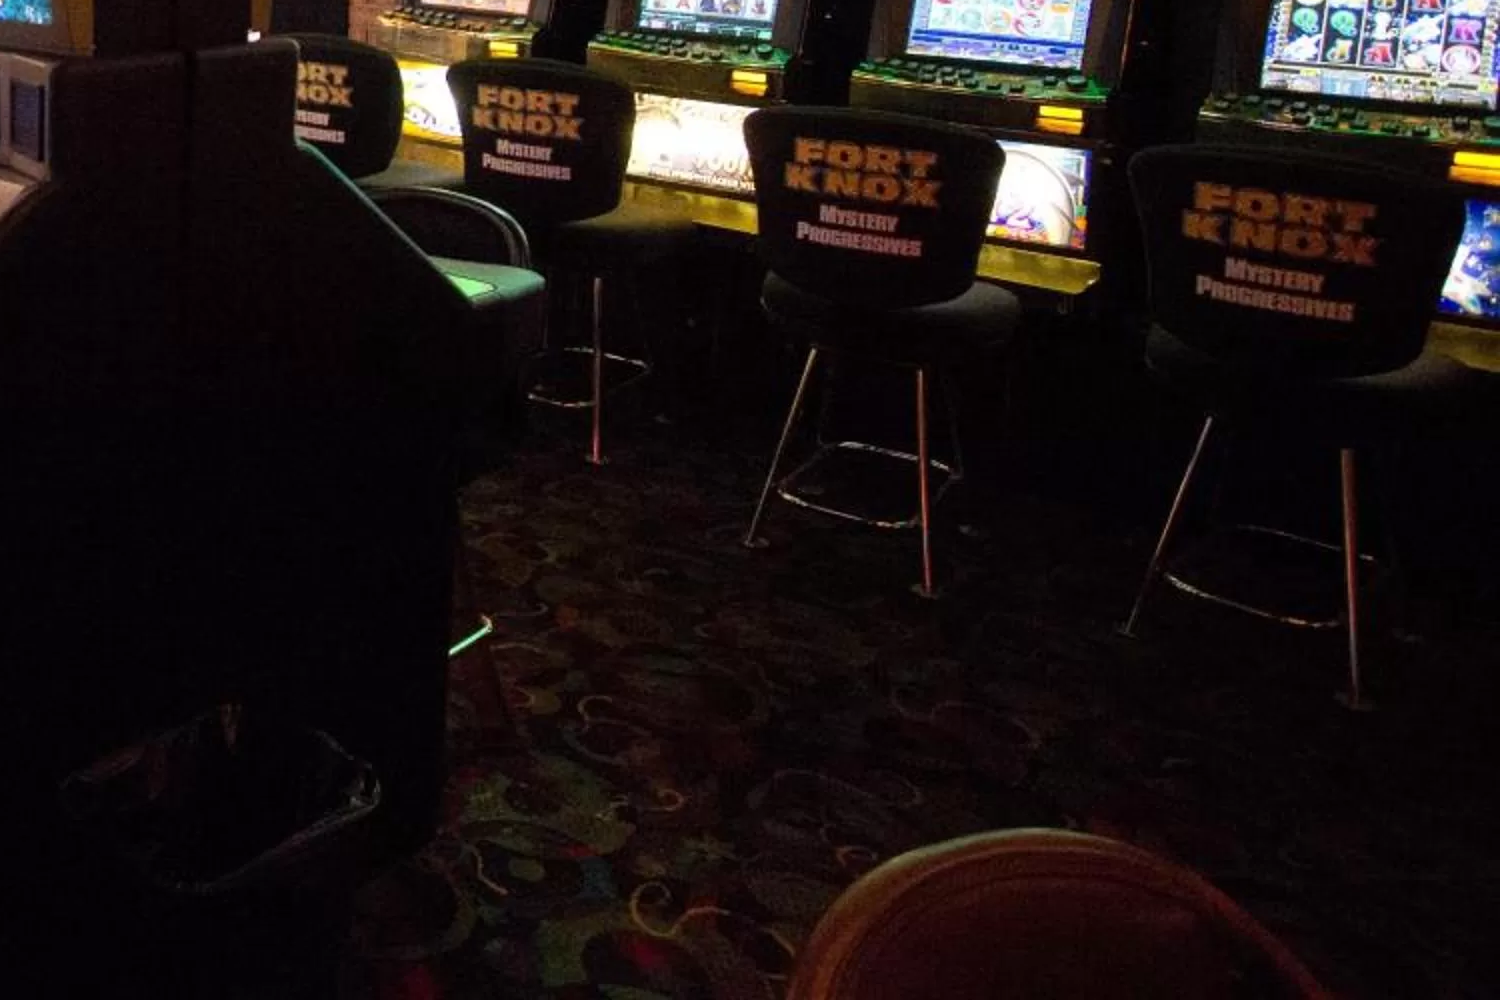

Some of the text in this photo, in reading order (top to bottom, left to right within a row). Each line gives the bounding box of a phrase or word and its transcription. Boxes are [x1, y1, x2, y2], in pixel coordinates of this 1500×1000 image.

[297, 61, 349, 86] RT
[296, 82, 354, 109] NOX
[478, 84, 579, 115] FORT
[472, 105, 585, 140] KNOX
[482, 152, 571, 180] PROGRESSIVES
[497, 139, 552, 161] MYSTERY
[794, 137, 937, 177] FORT
[784, 161, 944, 207] KNOX
[819, 203, 899, 232] MYSTERY
[1194, 181, 1378, 233] FORT
[797, 221, 922, 257] PROGRESSIVES
[1182, 208, 1381, 267] KNOX
[1225, 256, 1325, 293] MYSTERY
[1196, 275, 1356, 321] PROGRESSIVES
